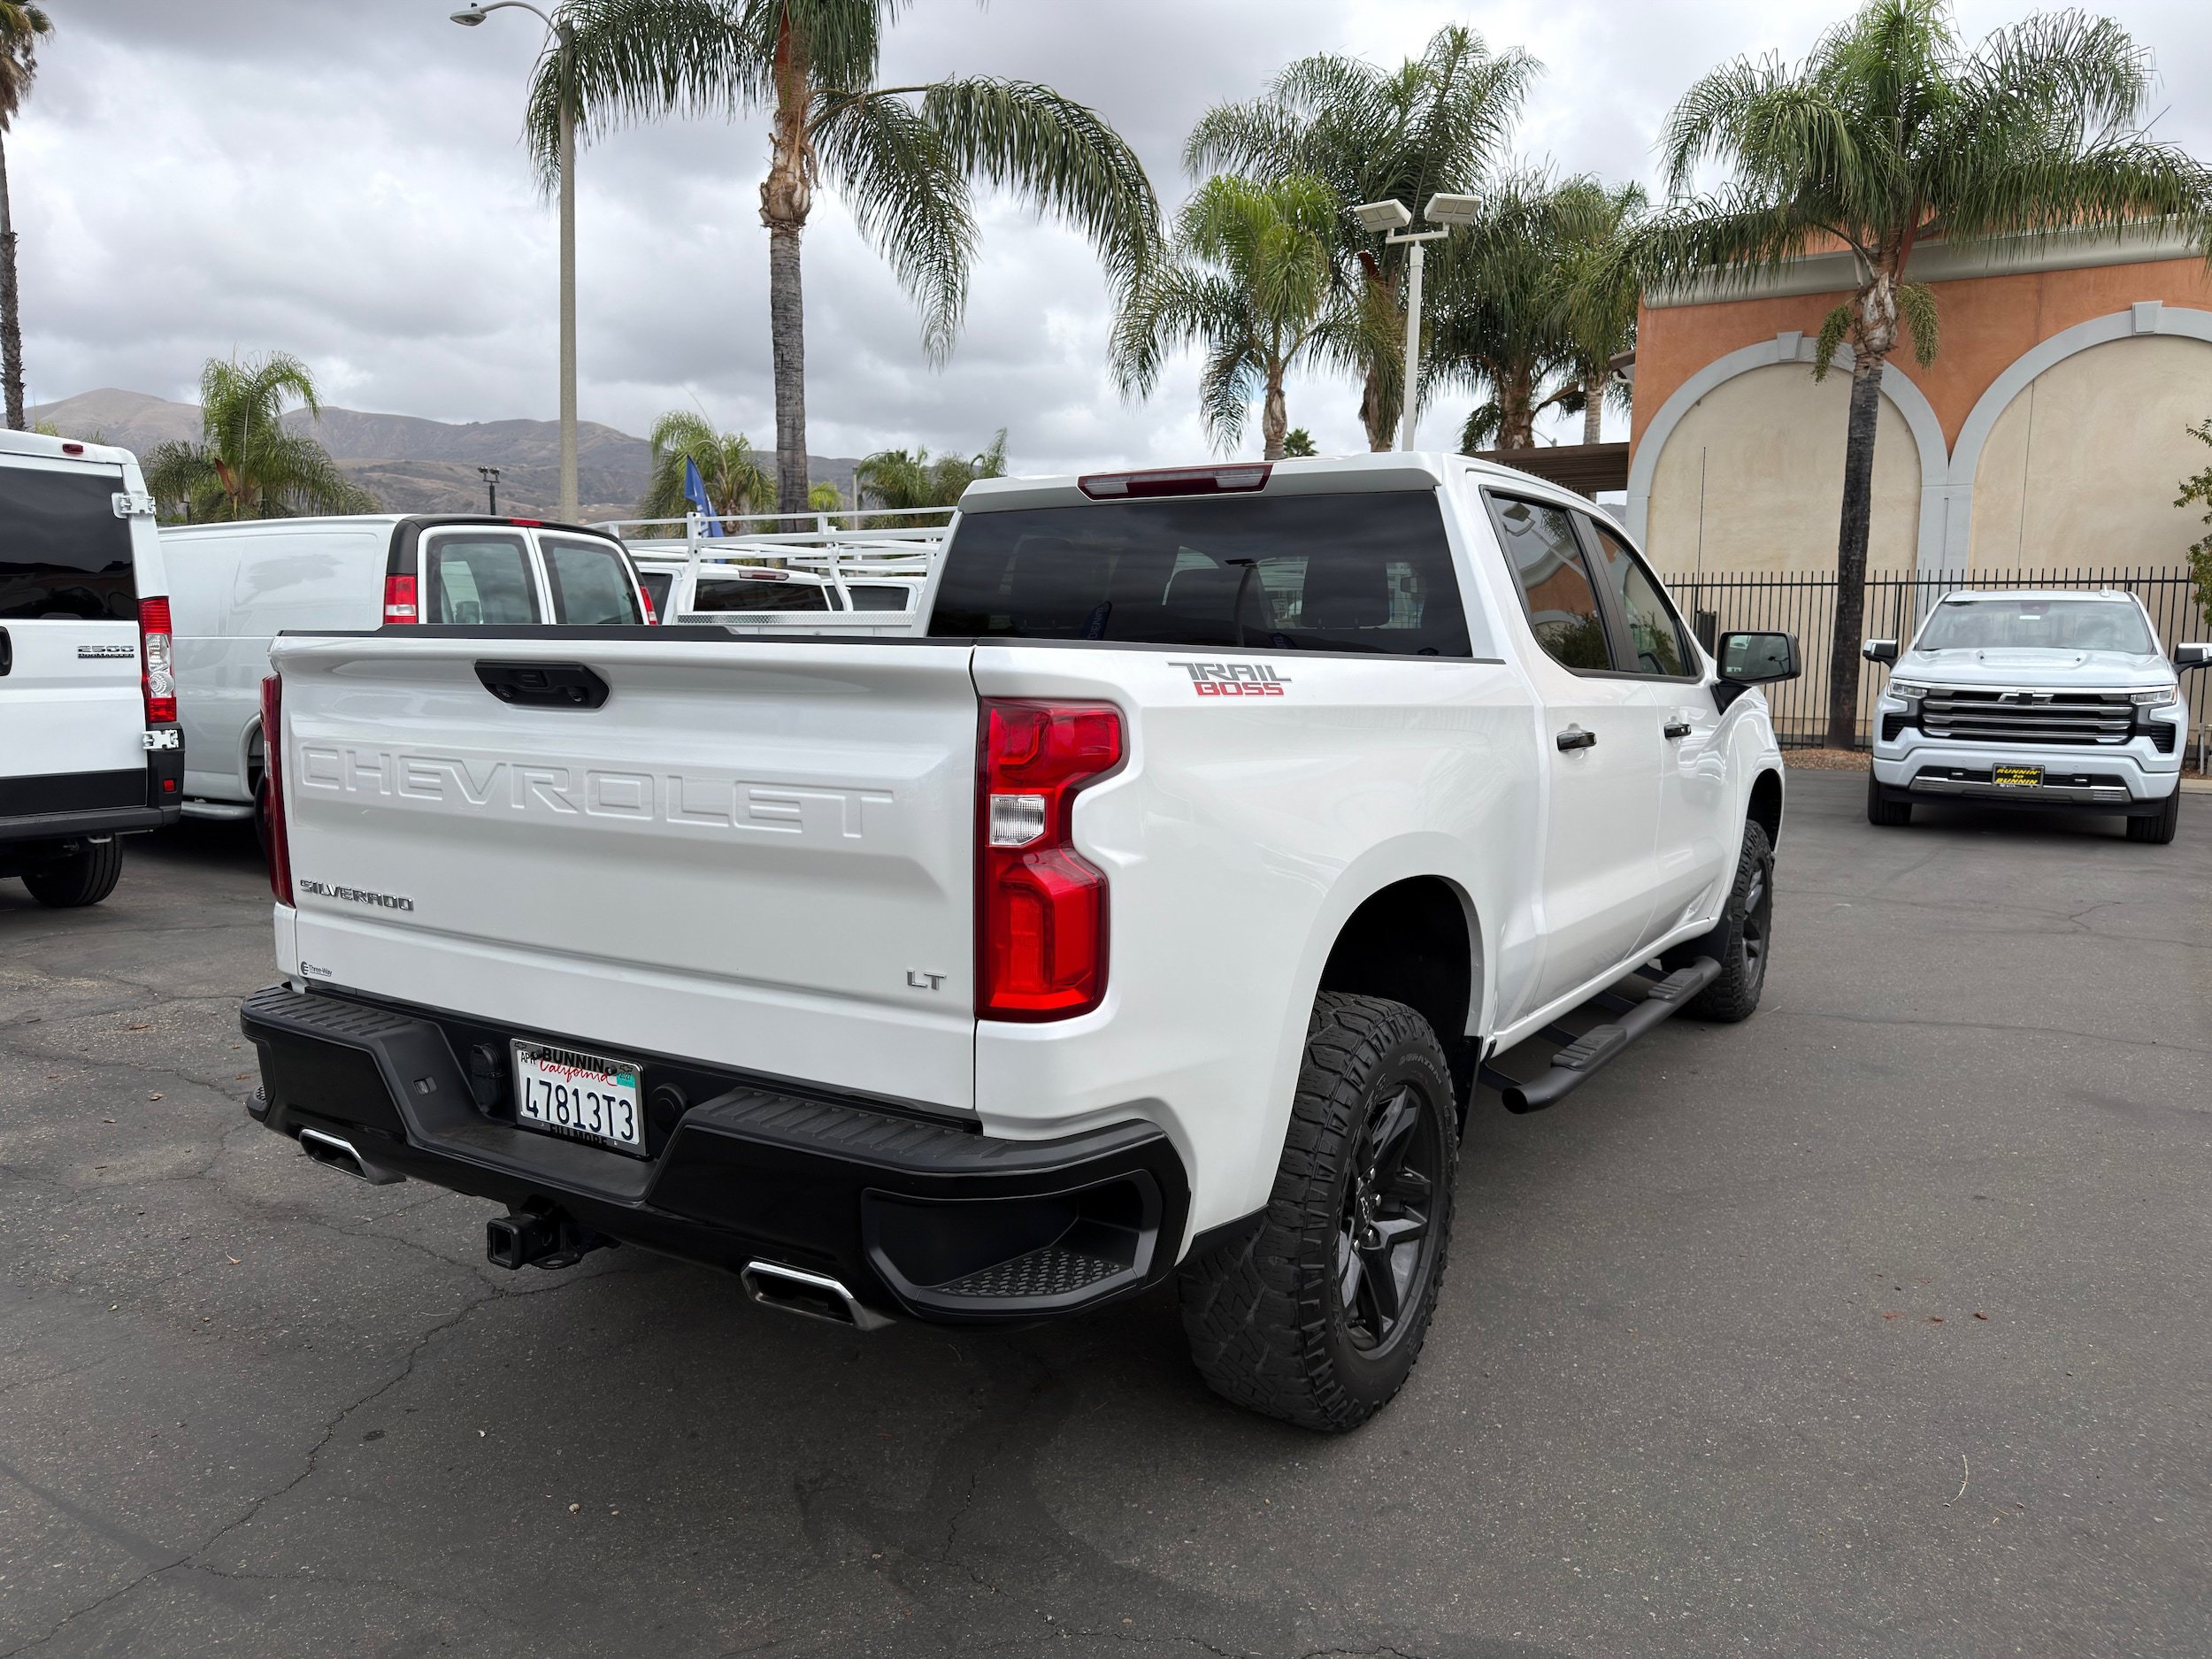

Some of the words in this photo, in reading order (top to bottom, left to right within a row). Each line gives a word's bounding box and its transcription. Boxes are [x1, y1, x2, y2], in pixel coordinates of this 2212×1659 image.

[1167, 662, 1292, 682] TRAIL
[1193, 681, 1284, 696] BOSS
[301, 746, 894, 838] CHEVROLET
[300, 879, 414, 911] SILVERADO
[308, 964, 333, 977] Three-Way
[906, 970, 947, 991] LT
[540, 1058, 618, 1087] California
[542, 1047, 604, 1074] BUNNIN
[526, 1077, 634, 1141] 47813T3
